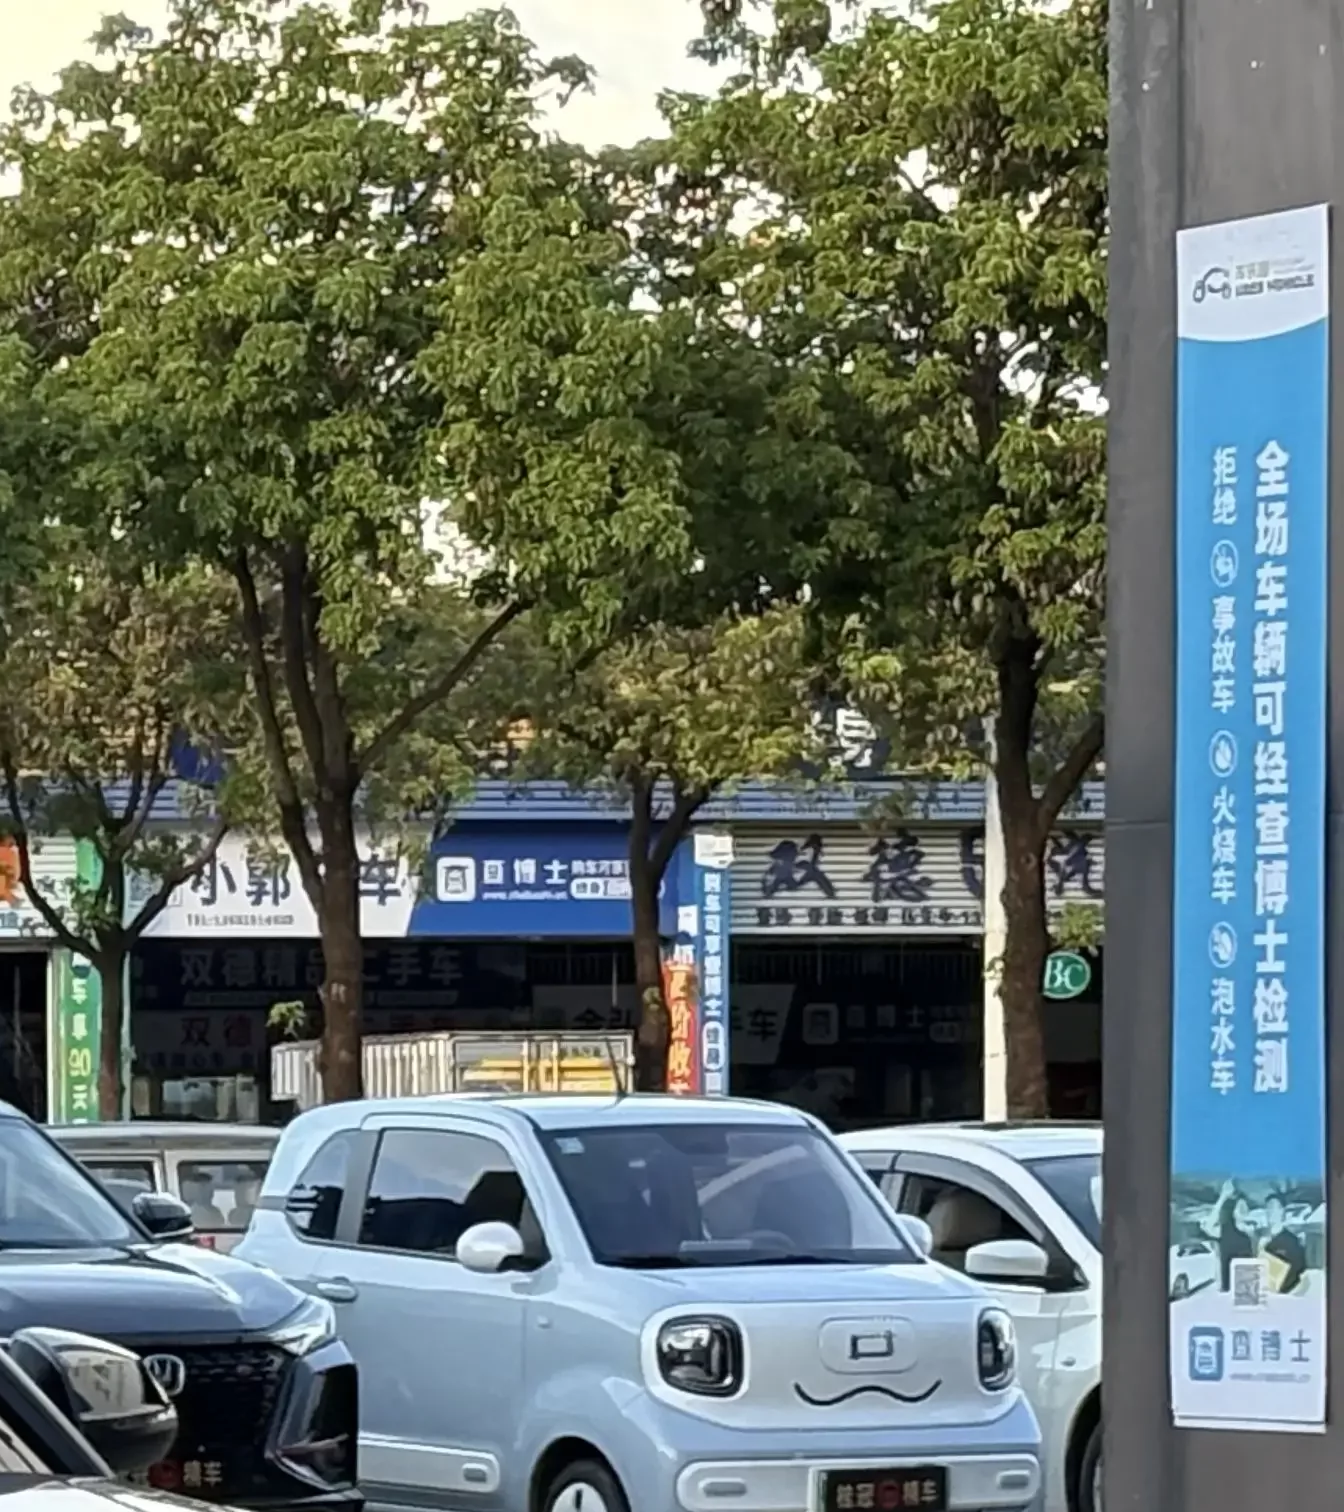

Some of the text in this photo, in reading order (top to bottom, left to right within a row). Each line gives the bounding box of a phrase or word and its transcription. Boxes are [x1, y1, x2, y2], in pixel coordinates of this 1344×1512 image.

[1212, 446, 1237, 525] 拒绝
[1253, 440, 1289, 1093] 全场车辆可经查博士检测
[190, 838, 402, 907] 小郭车
[482, 859, 569, 886] 查博士
[1212, 786, 1236, 905] 火烧车
[1210, 977, 1236, 1095] 泡水车
